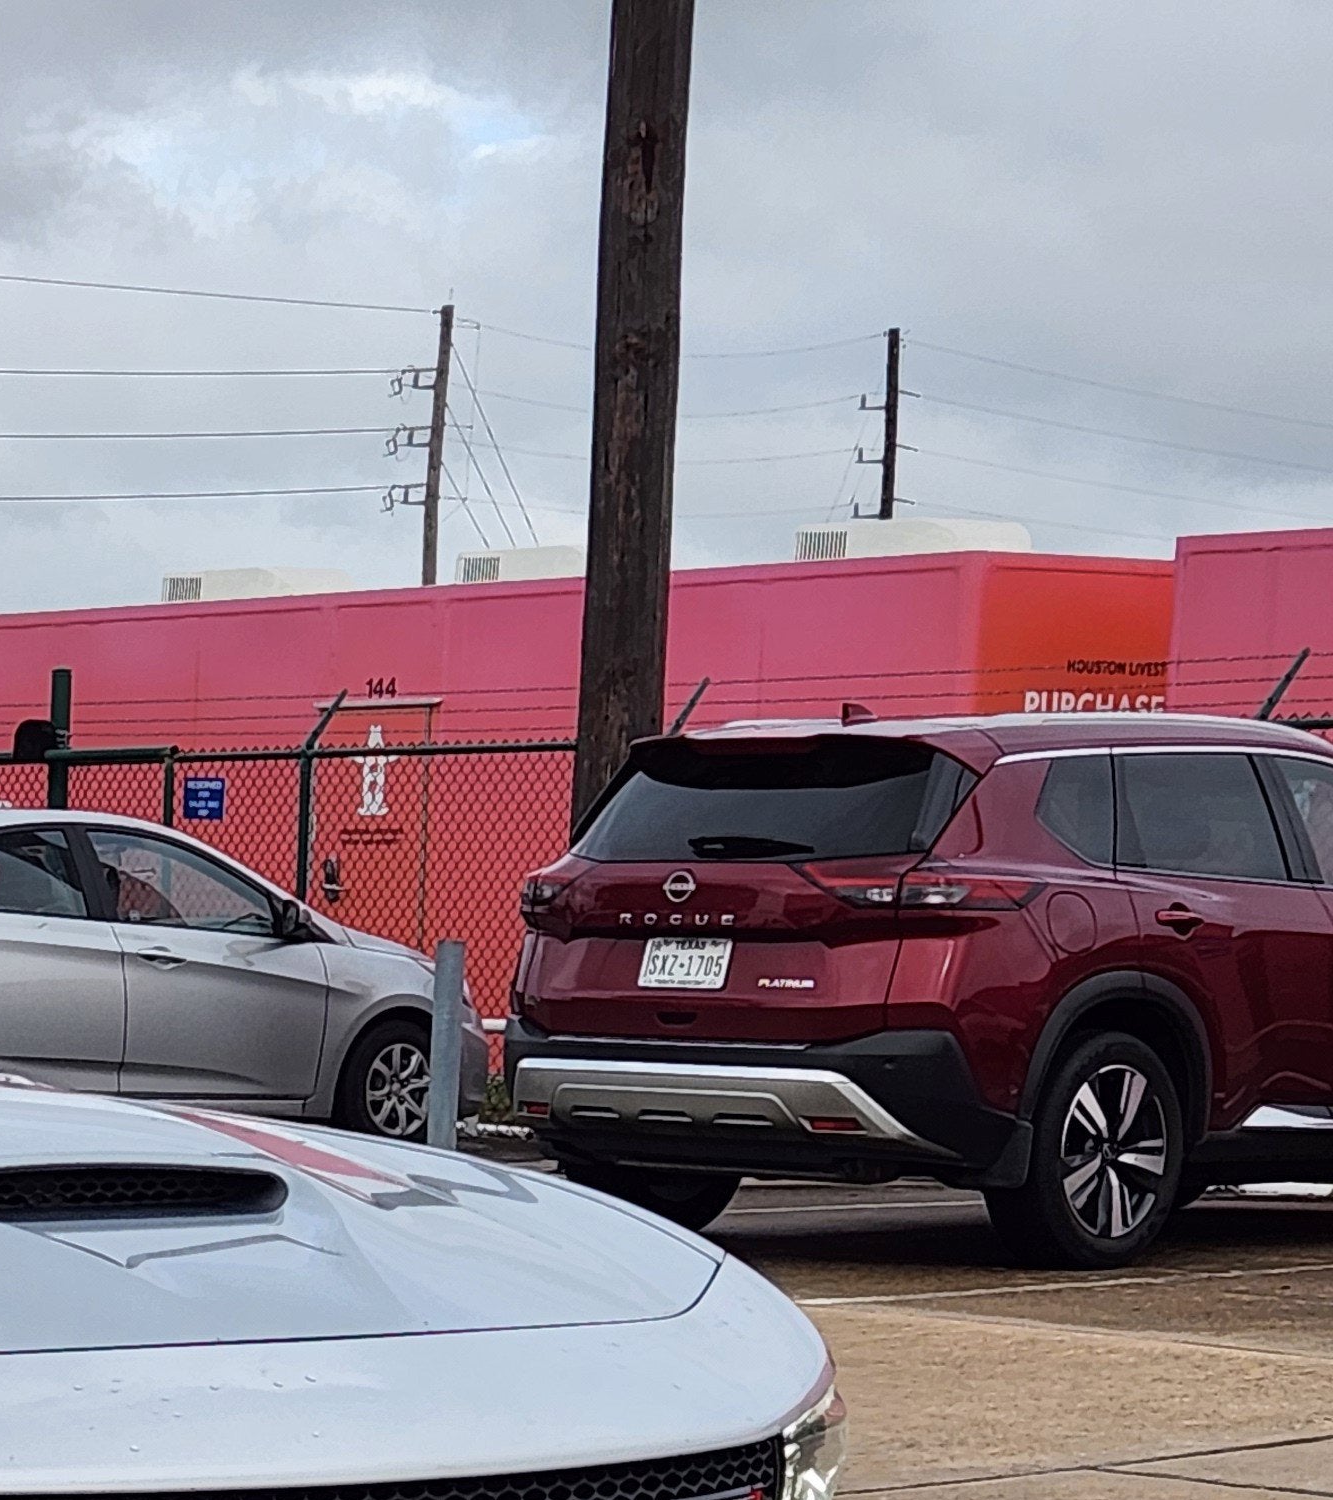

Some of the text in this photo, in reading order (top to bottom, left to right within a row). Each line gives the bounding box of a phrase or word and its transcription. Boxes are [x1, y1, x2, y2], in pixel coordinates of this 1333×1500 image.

[1066, 659, 1126, 675] HOUSTON
[366, 677, 397, 698] 144
[1024, 690, 1165, 713] PURCHASE
[619, 913, 734, 925] ROGUE
